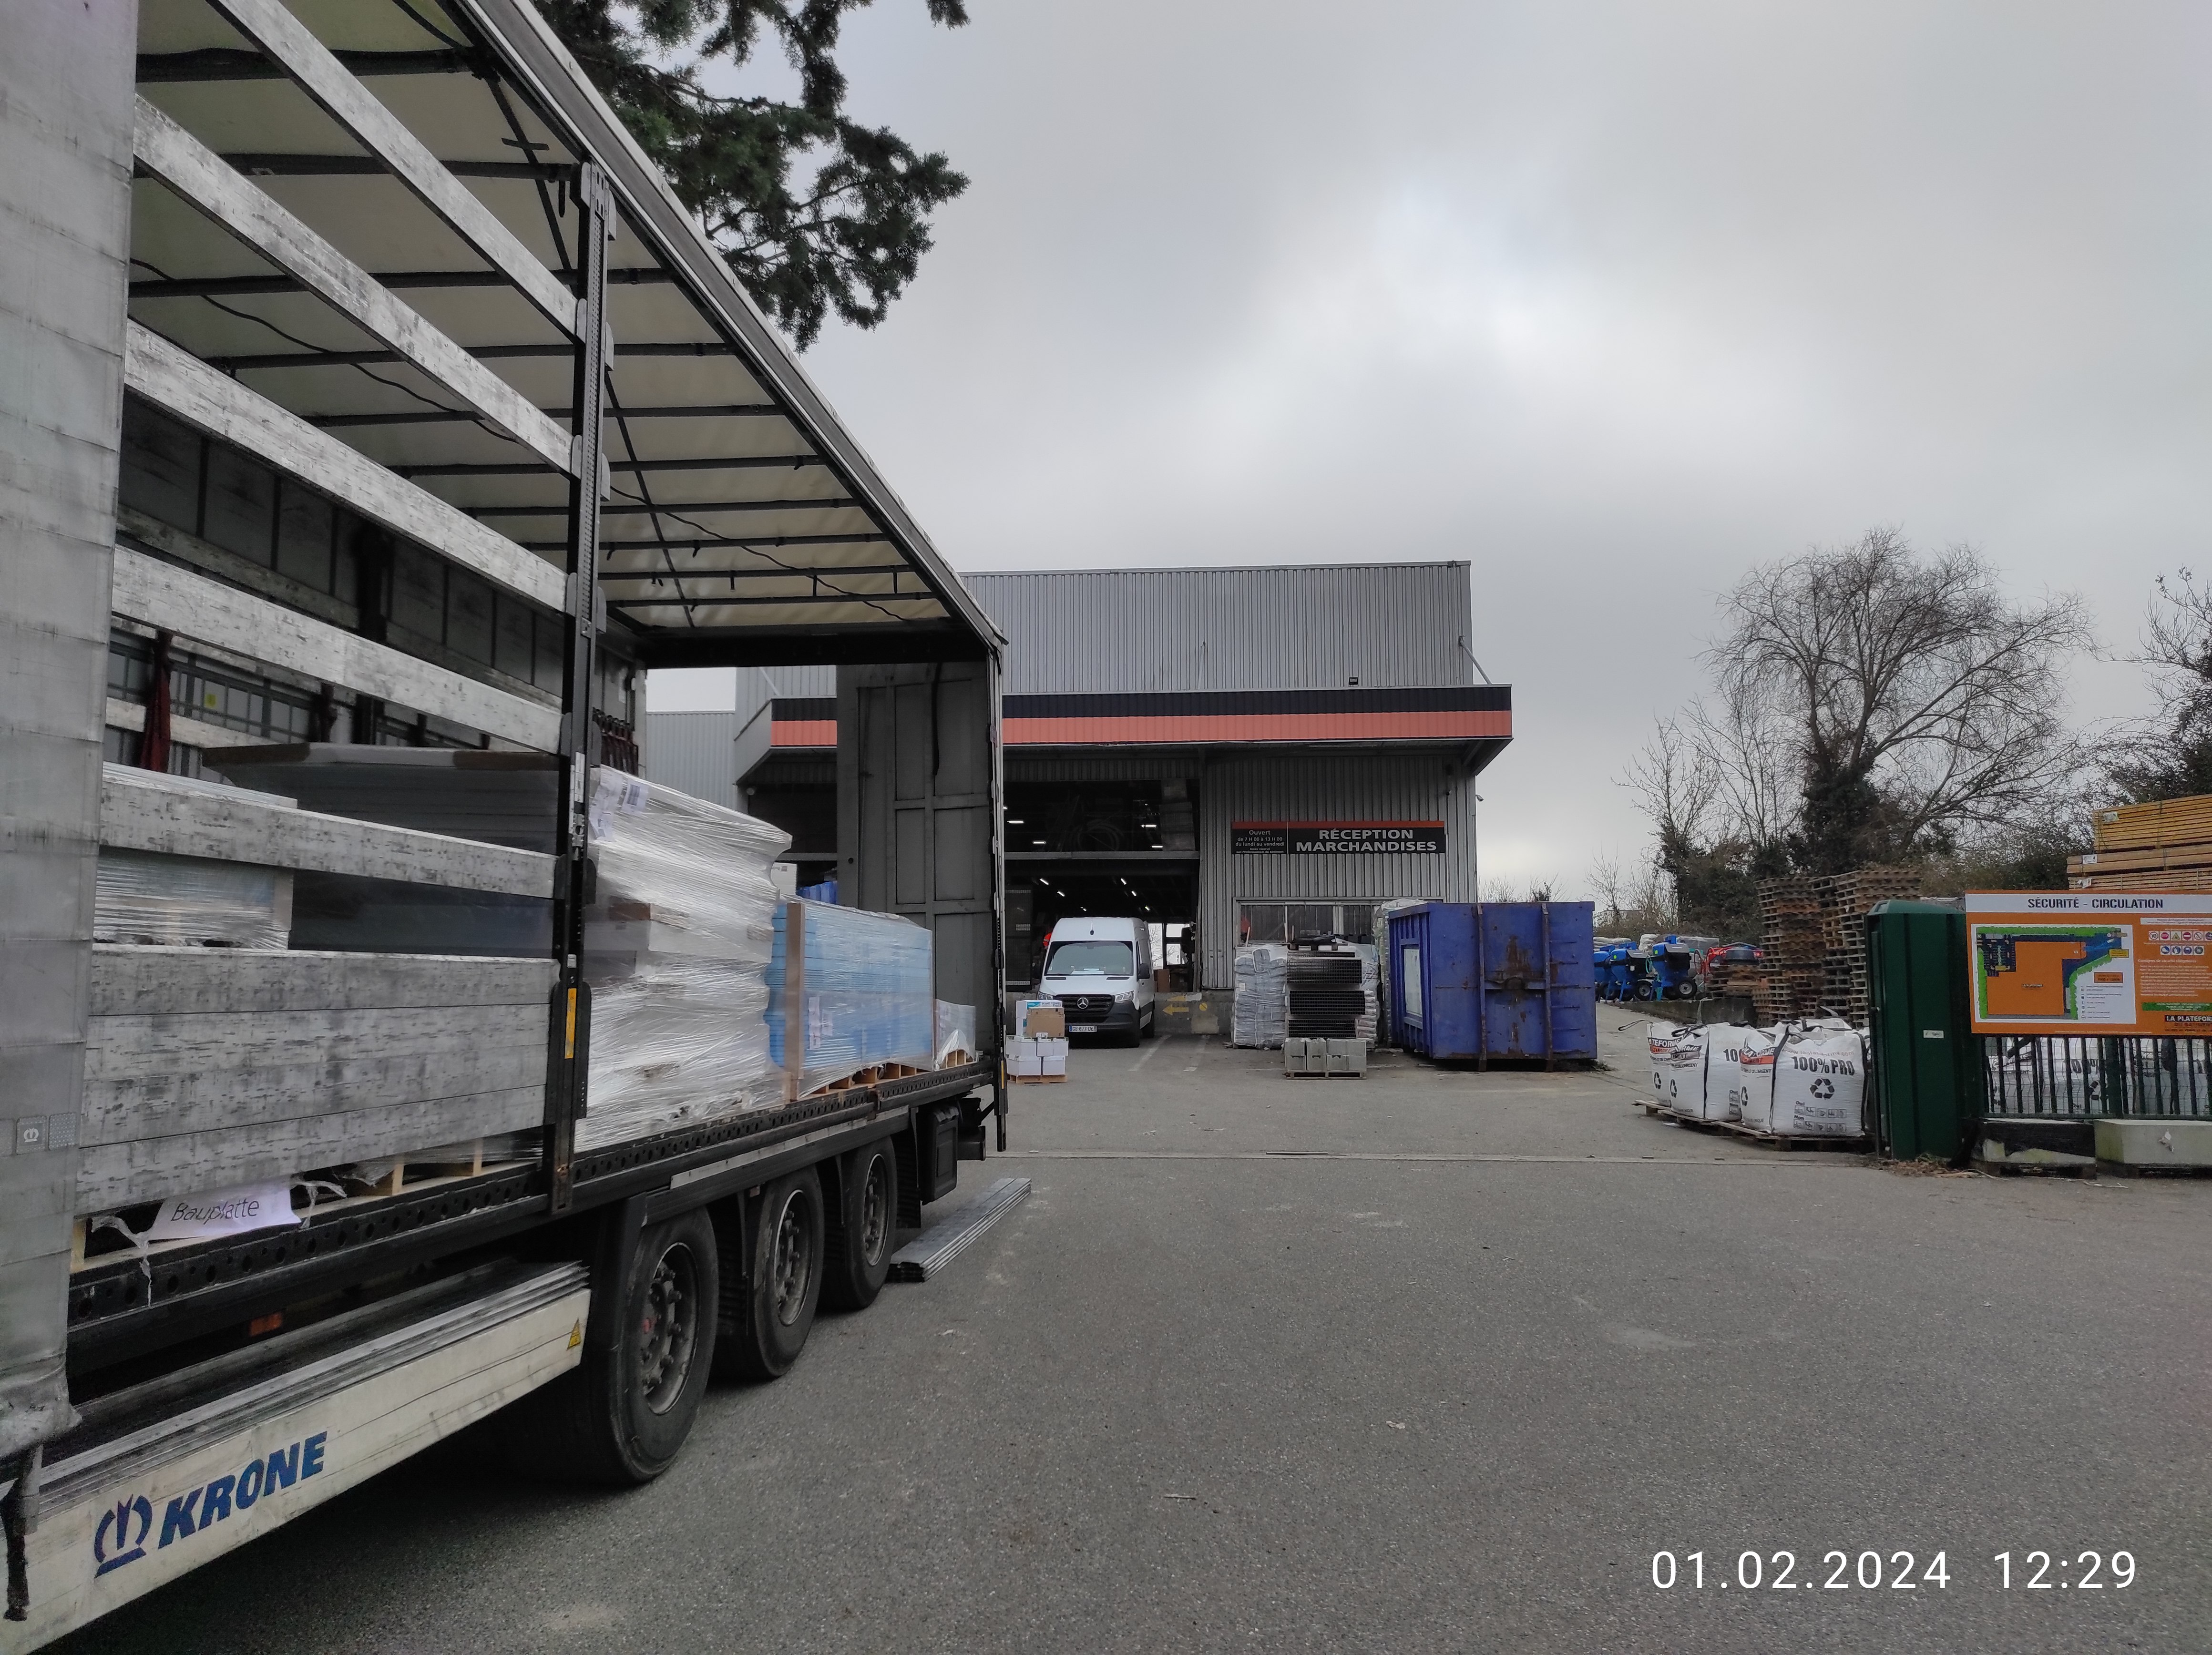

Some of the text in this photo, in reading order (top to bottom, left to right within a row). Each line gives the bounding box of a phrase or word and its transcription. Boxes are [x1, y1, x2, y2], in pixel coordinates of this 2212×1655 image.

[1319, 828, 1413, 839] RÉCEPTION
[1296, 841, 1437, 851] MARCHANDISES
[2028, 897, 2079, 908] SÉCURITÉ
[2092, 899, 2163, 908] CIRCULATION
[171, 1198, 260, 1226] Bauplatte
[158, 1431, 328, 1550] KRONE
